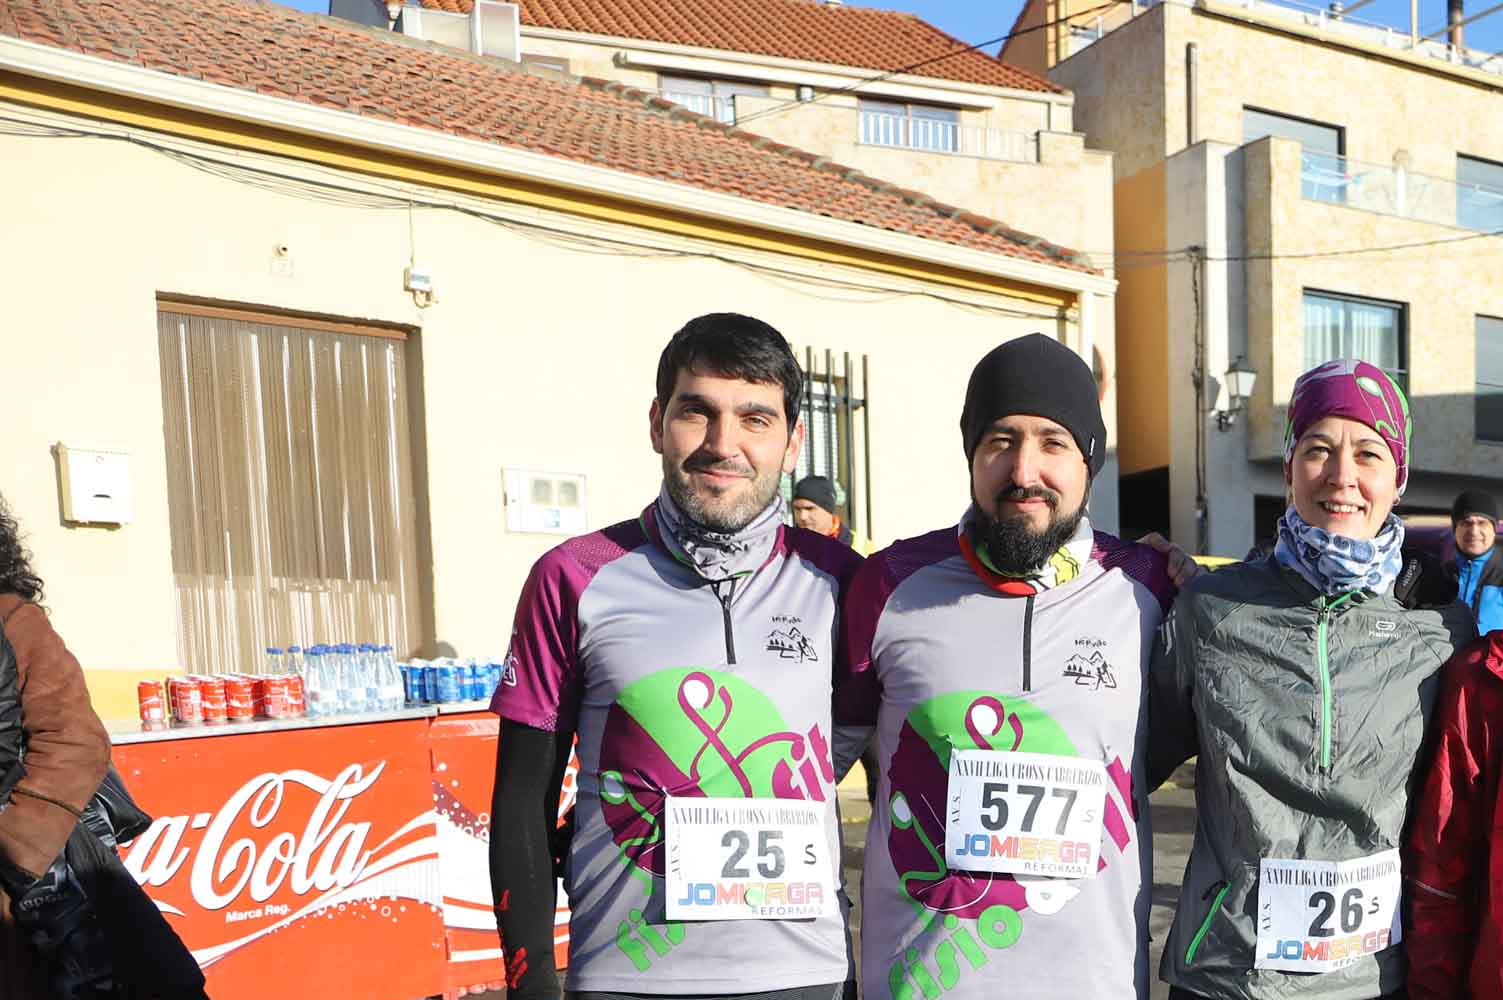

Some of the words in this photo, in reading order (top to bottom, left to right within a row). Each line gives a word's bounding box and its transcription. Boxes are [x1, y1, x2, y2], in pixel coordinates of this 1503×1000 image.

[955, 759, 983, 777] XXVII
[986, 761, 1009, 778] LIGA
[1012, 763, 1045, 782] CROSS
[705, 807, 729, 825] LIGA
[980, 782, 1078, 836] 577
[720, 830, 785, 879] 25
[803, 844, 817, 865] S
[955, 833, 1091, 865] JOMISAGA
[1295, 869, 1317, 887] LIGA
[225, 908, 263, 923] Marca
[1308, 887, 1364, 937] 26
[1367, 896, 1380, 915] S
